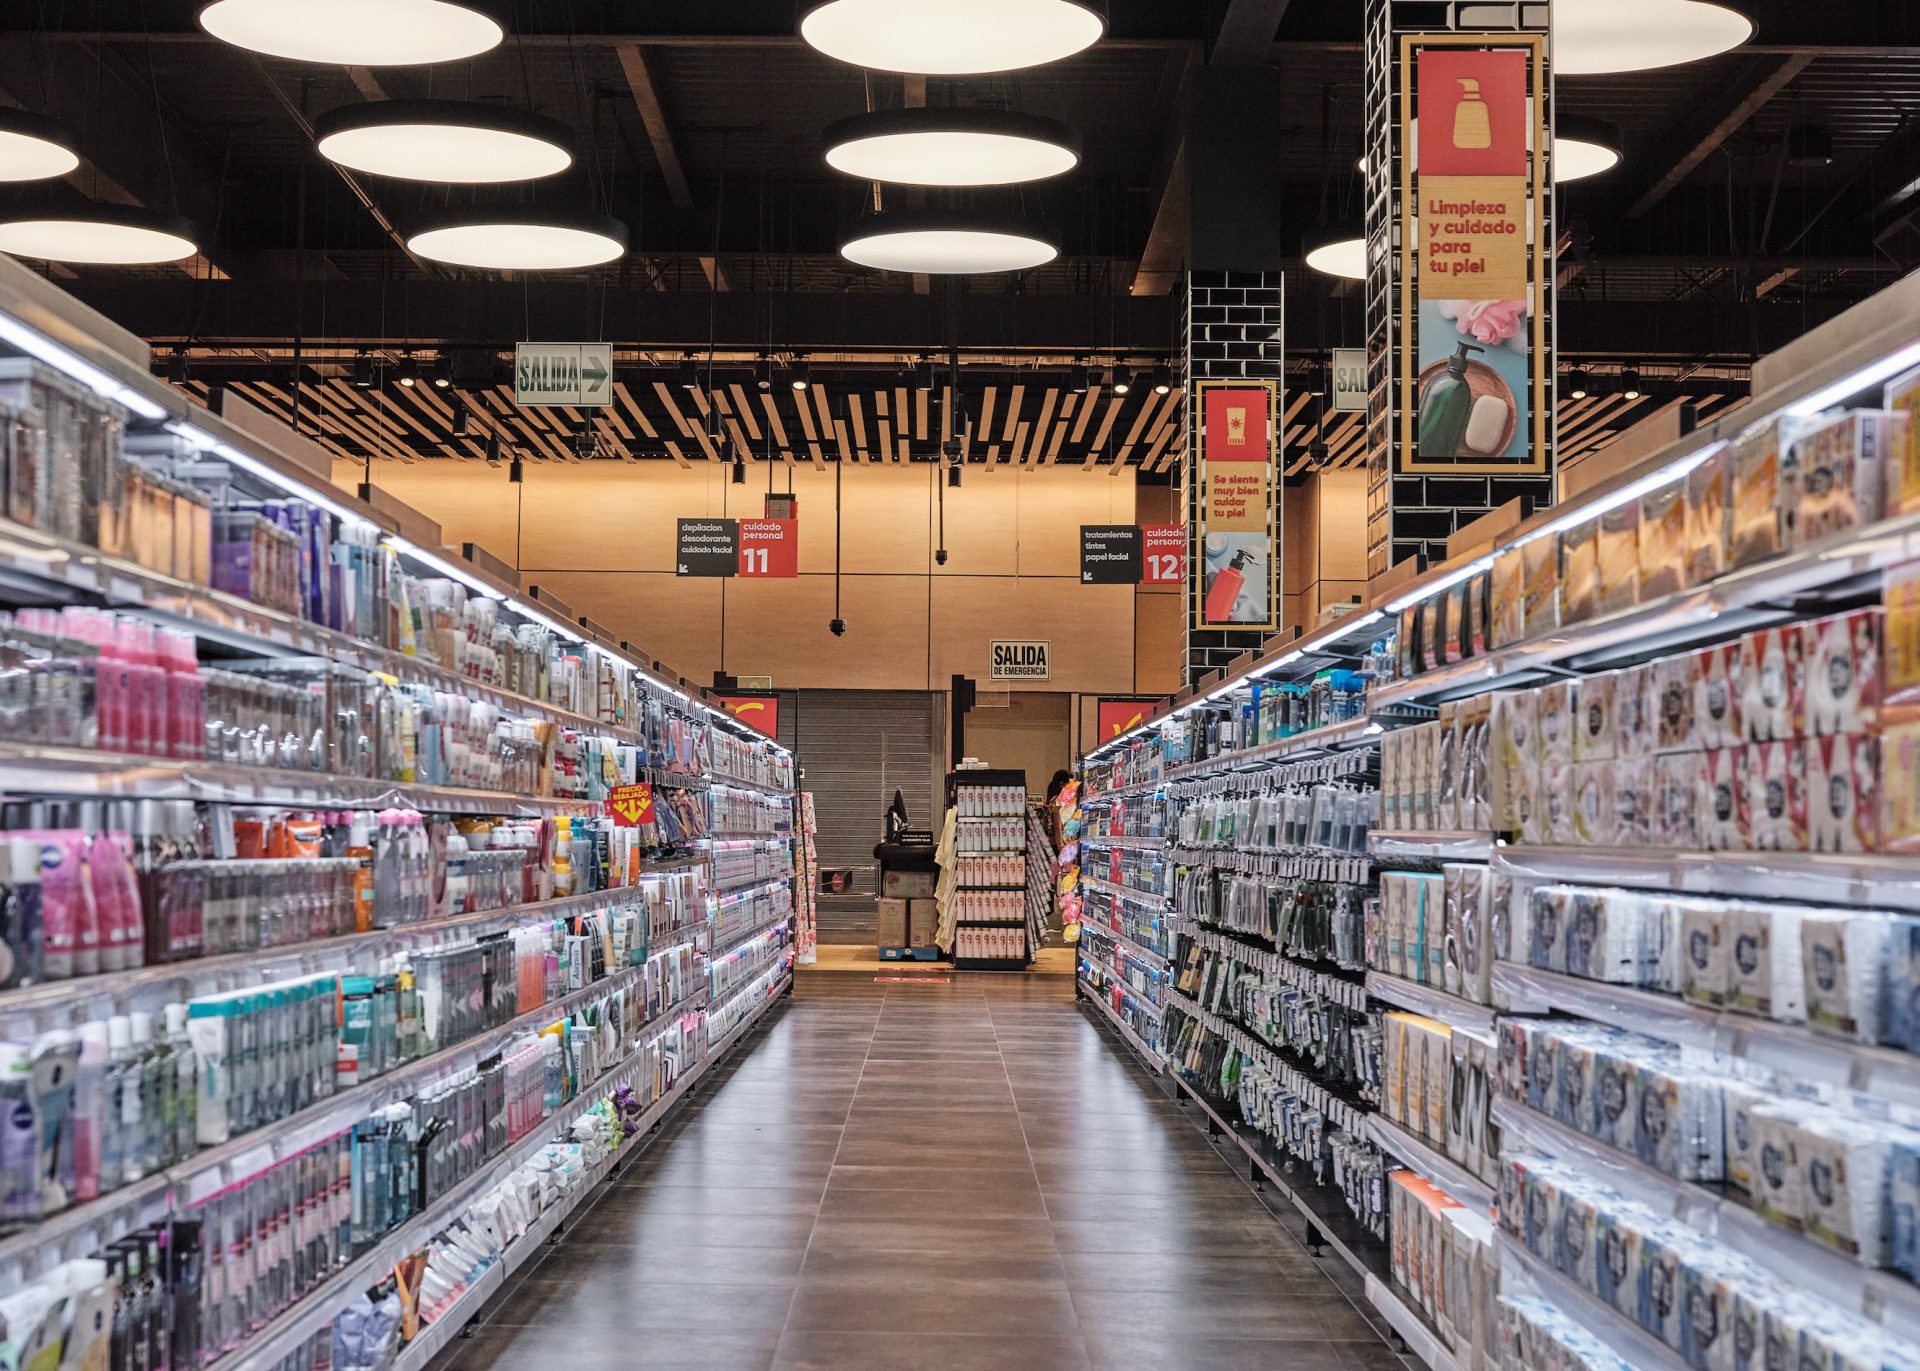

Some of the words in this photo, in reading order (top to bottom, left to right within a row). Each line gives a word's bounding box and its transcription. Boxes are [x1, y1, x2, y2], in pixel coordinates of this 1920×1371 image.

[1430, 200, 1506, 217] Limpieza
[1430, 222, 1440, 237] y
[1444, 220, 1516, 234] cuidado
[1430, 242, 1471, 256] para
[1430, 260, 1448, 272] tu
[1453, 258, 1484, 276] piel
[520, 356, 578, 392] SALIDA
[1214, 475, 1226, 484] Se
[1229, 475, 1259, 484] siente
[1214, 487, 1234, 496] muy
[1238, 486, 1259, 494] bien
[1214, 498, 1246, 506] cuidar
[1227, 508, 1245, 518] piel
[744, 523, 781, 531] cuidado
[744, 532, 783, 540] personal
[743, 548, 768, 572] 11
[1086, 553, 1107, 562] papel
[1148, 554, 1178, 580] 12
[994, 645, 1046, 666] SALIDA
[994, 667, 1002, 675] DE
[1004, 667, 1046, 675] EMERGENCIA
[613, 790, 648, 800] REBAJADO
[618, 785, 642, 793] PRECIO
[1312, 1014, 1320, 1040] Gillette
[1372, 1179, 1381, 1212] Gillette
